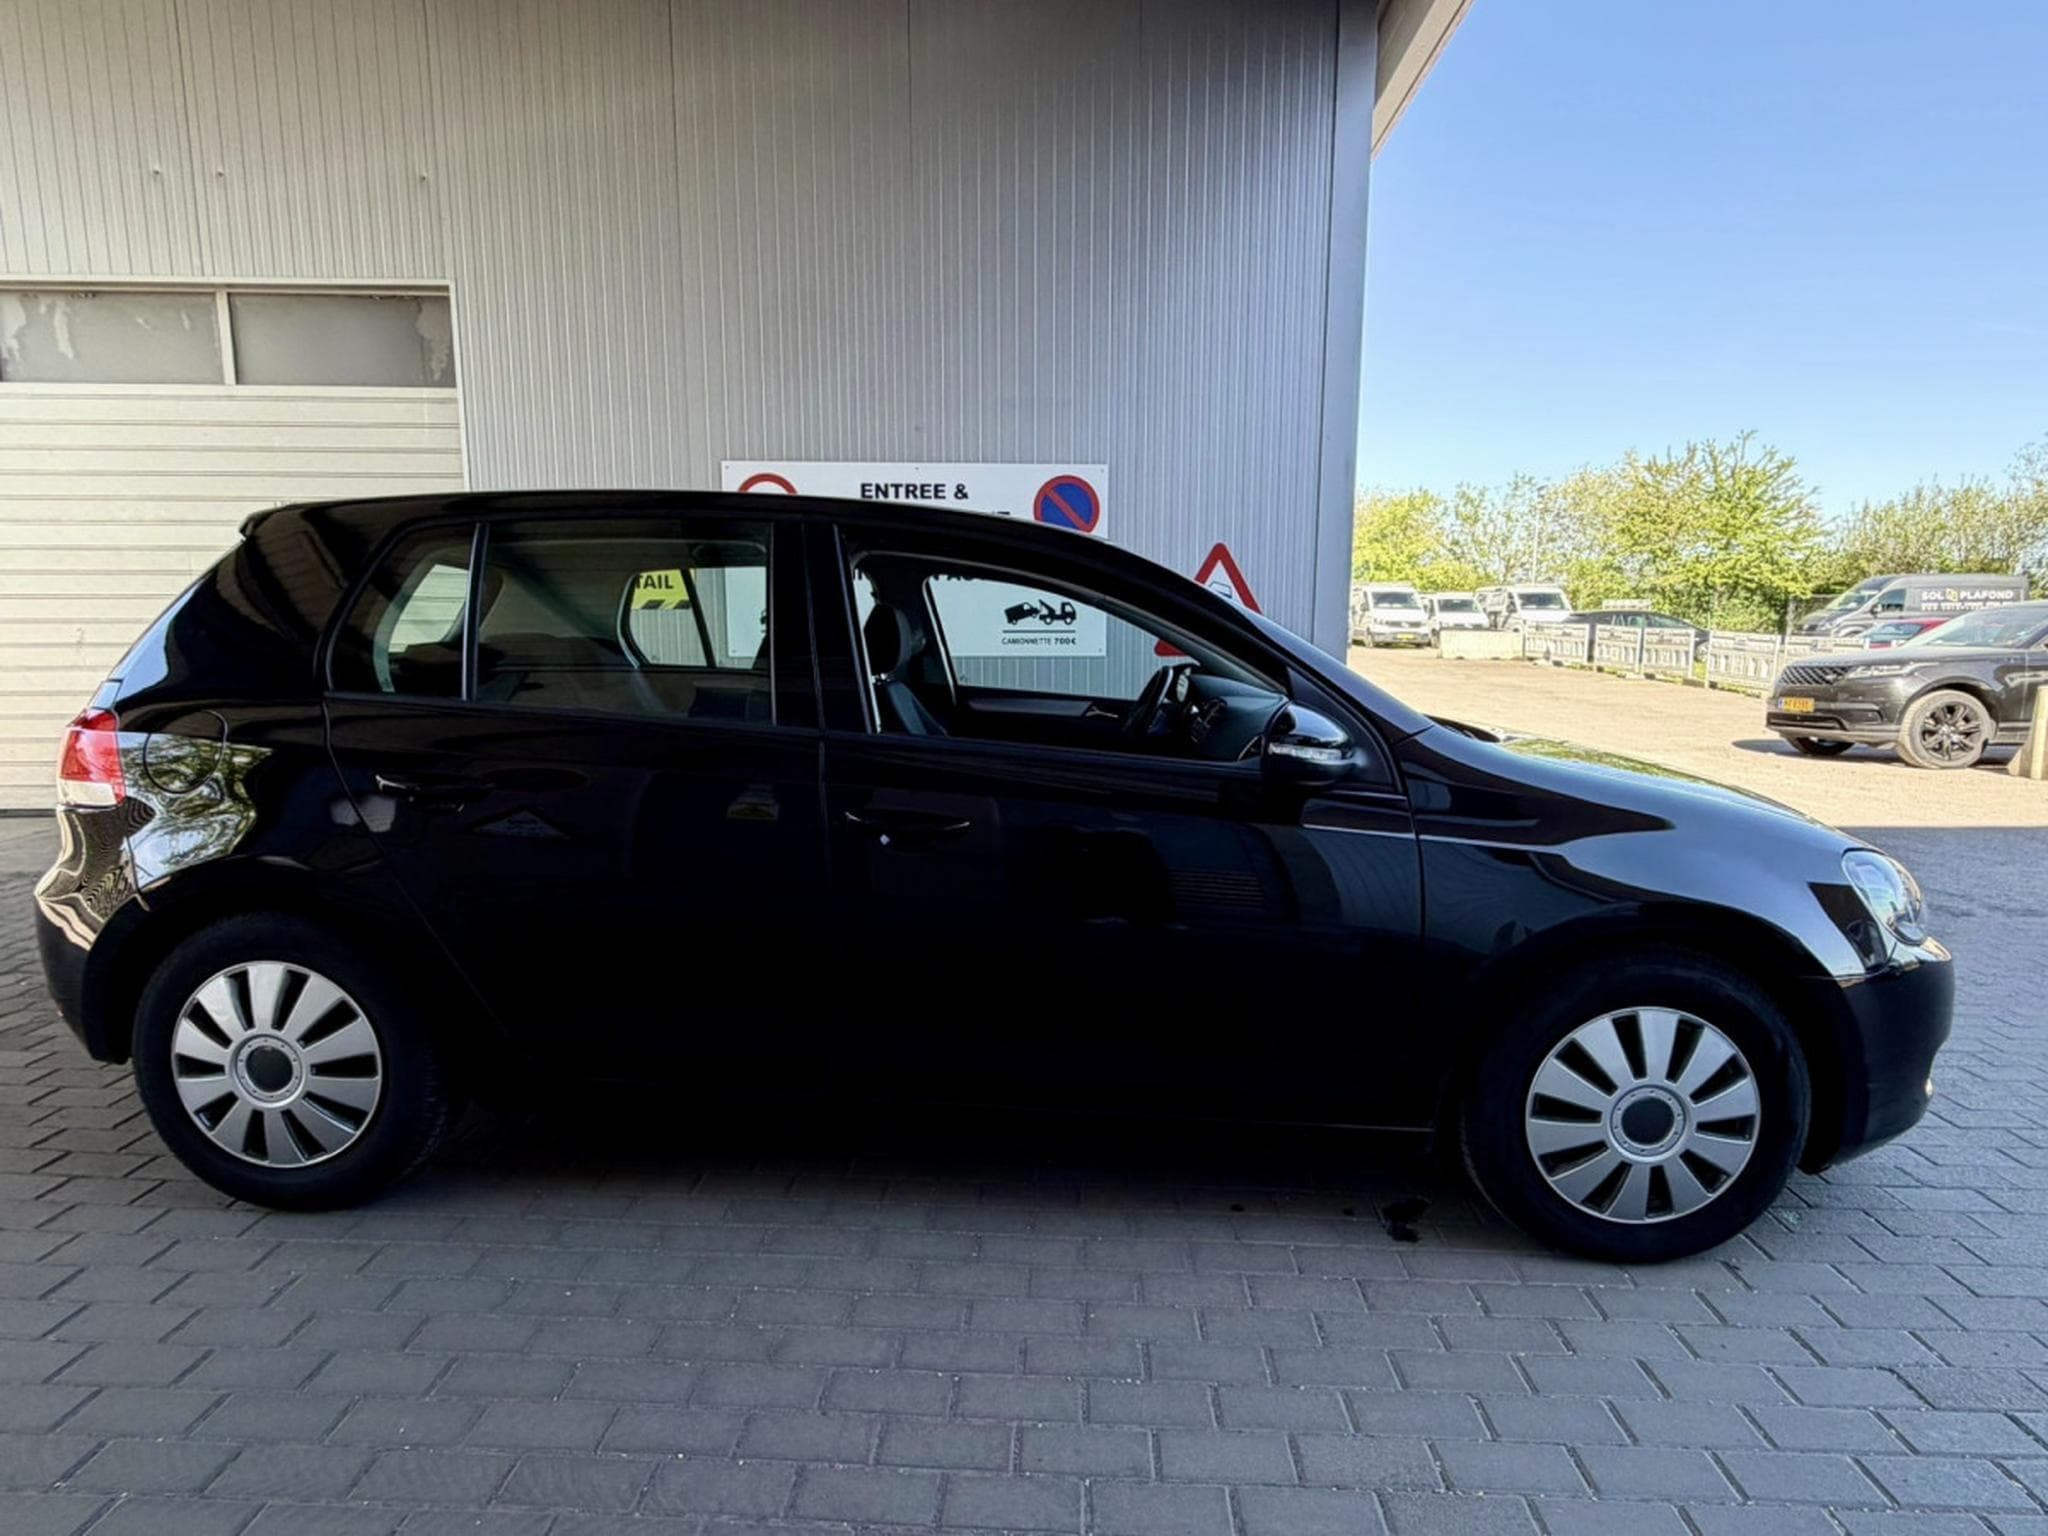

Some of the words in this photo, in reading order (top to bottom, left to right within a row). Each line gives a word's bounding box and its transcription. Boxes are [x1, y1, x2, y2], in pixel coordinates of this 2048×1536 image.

[861, 483, 946, 499] ENTREE
[954, 483, 969, 499] &
[1921, 590, 1944, 600] SOL
[1959, 589, 2014, 600] PLAFOND
